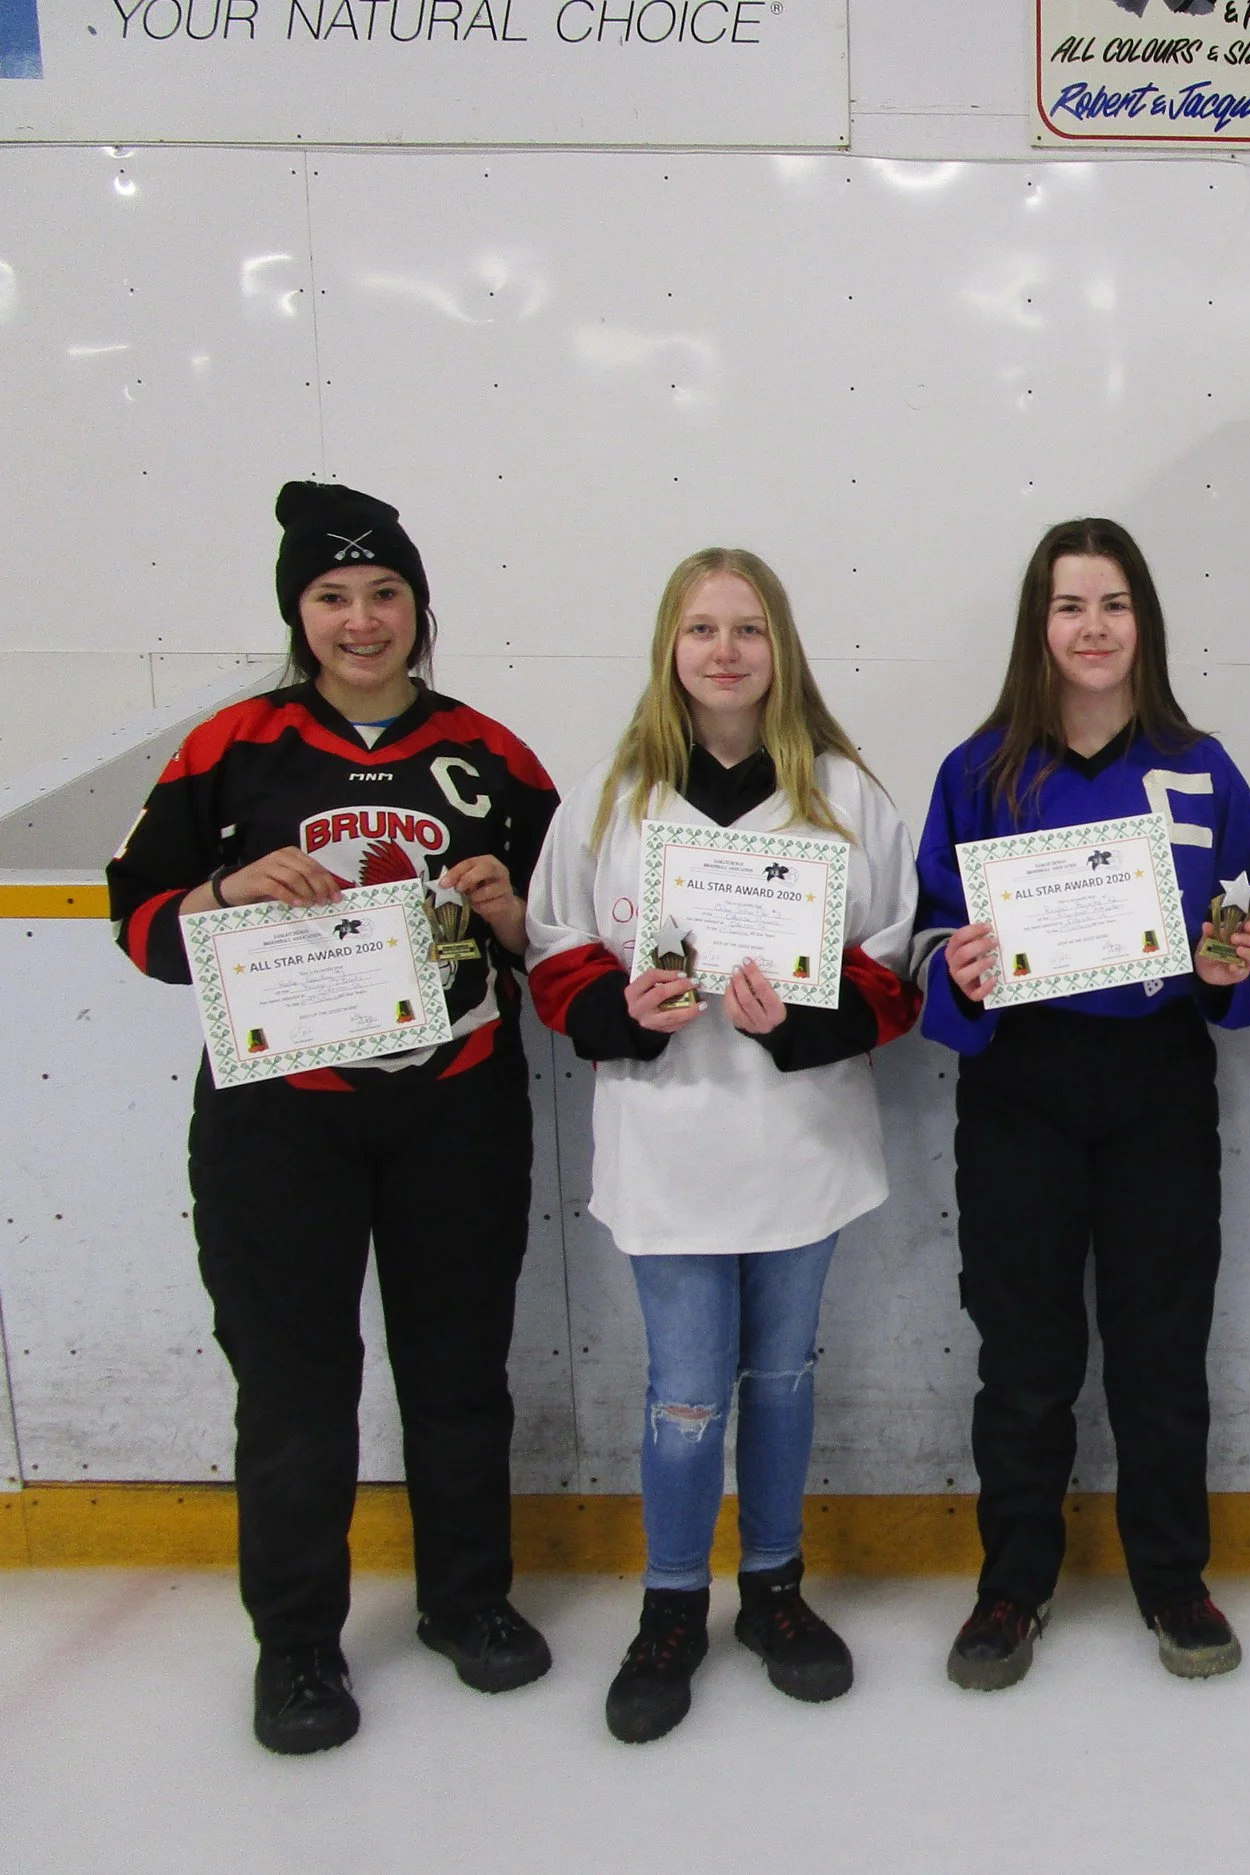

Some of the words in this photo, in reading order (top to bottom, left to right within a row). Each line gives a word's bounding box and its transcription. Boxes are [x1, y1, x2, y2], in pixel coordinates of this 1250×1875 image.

[114, 0, 258, 39] YOUR
[287, 0, 527, 41] NATURAL
[1224, 0, 1239, 23] &
[1050, 36, 1096, 63] ALL
[1102, 37, 1203, 64] COLOURS
[1207, 45, 1219, 62] &
[1050, 81, 1160, 121] Robert
[1150, 94, 1167, 116] &
[430, 756, 492, 819] C
[305, 811, 444, 854] BRUNO
[687, 879, 705, 890] ALL
[707, 881, 733, 893] STAR
[735, 885, 774, 898] AWARD
[777, 890, 802, 902] 2020
[1015, 888, 1034, 900] ALL
[1036, 883, 1062, 896] STAR
[1064, 877, 1104, 892] AWARD
[1106, 872, 1131, 885] 2020
[250, 961, 271, 973] ALL
[274, 955, 304, 969] STAR
[307, 946, 352, 963] AWARD
[356, 940, 384, 954] 2020
